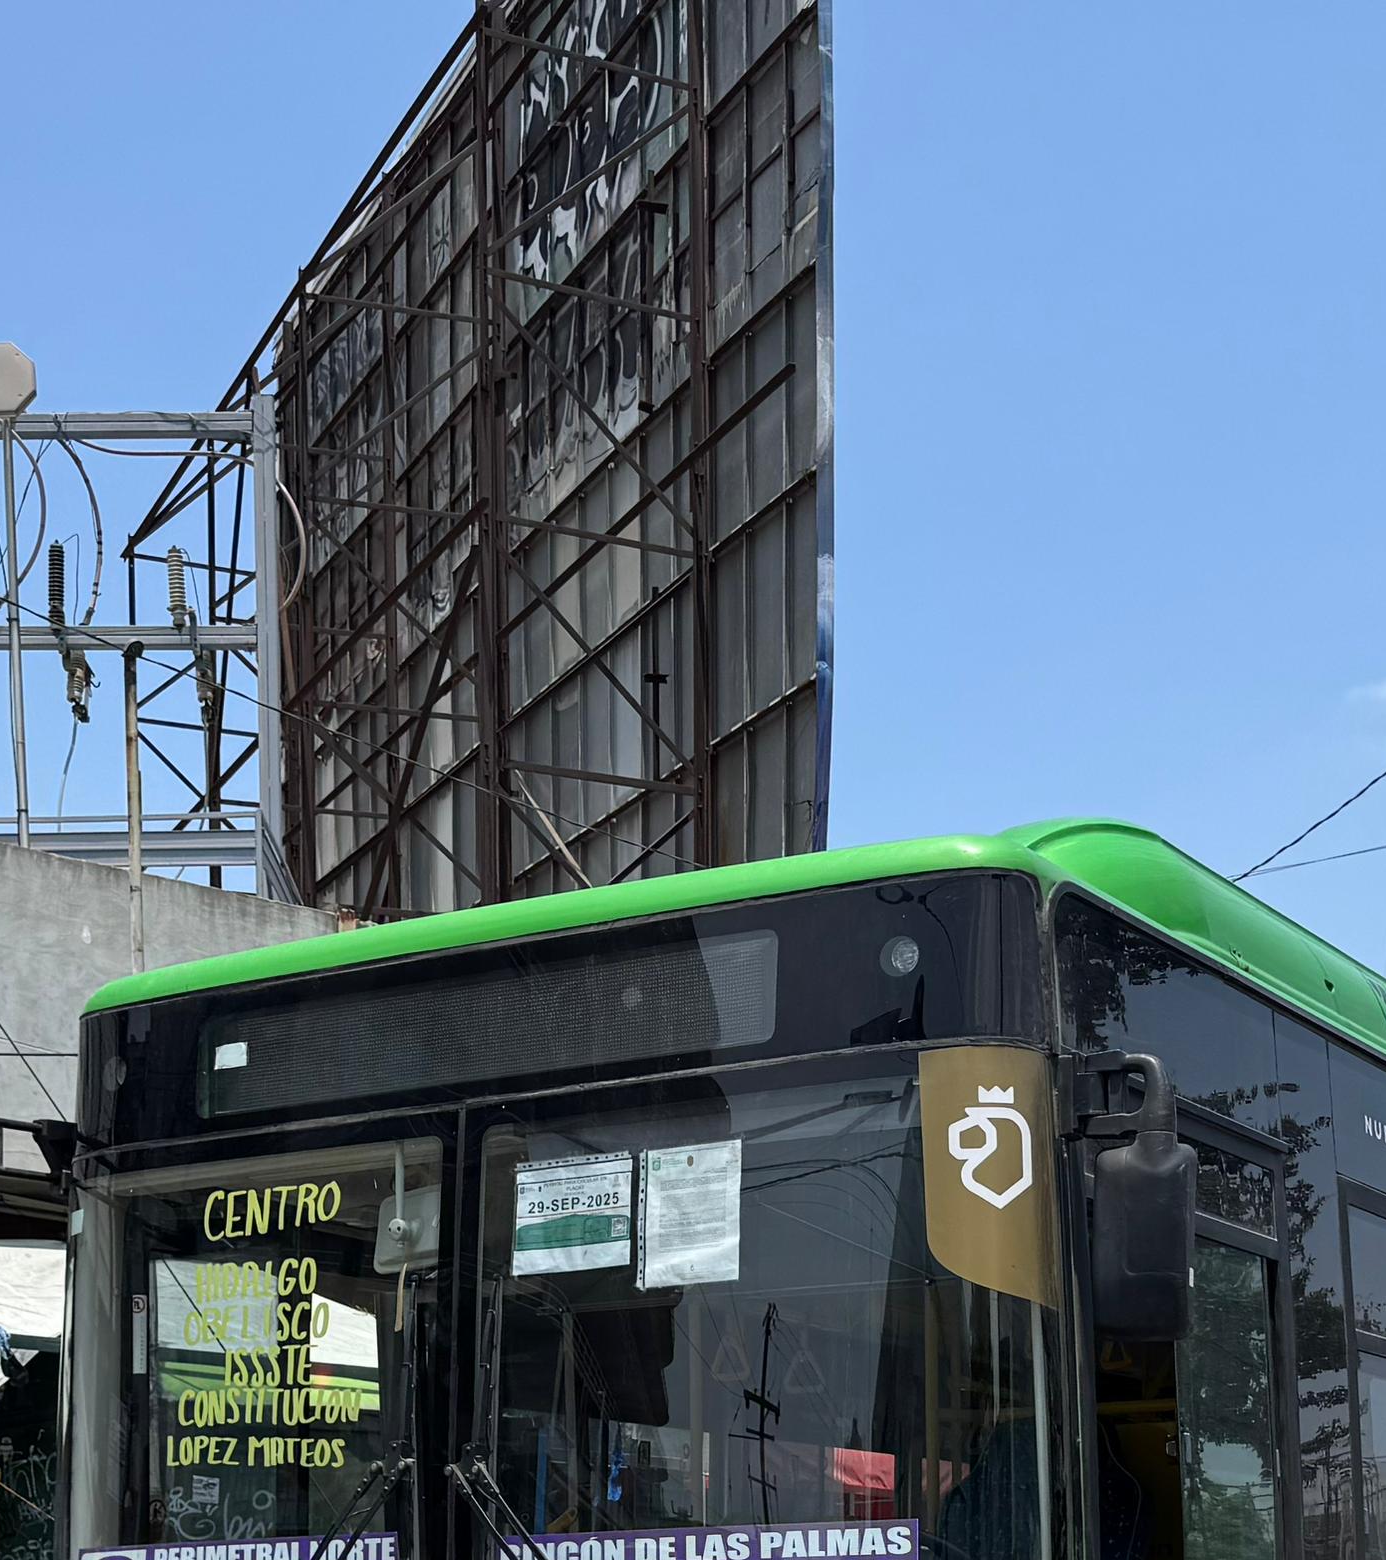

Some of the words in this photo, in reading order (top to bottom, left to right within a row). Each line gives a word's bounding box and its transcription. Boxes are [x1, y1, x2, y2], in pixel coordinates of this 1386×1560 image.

[202, 1179, 342, 1242] CENTRO
[527, 1191, 620, 1214] 29-SEP-2025
[195, 1256, 318, 1305] HIDALGO
[182, 1301, 330, 1346] OBELISCO
[177, 1387, 362, 1427] CONSTITUCION
[166, 1435, 240, 1468] LOPEZ
[247, 1436, 346, 1468] MATEOS
[760, 1526, 912, 1559] PALMAS
